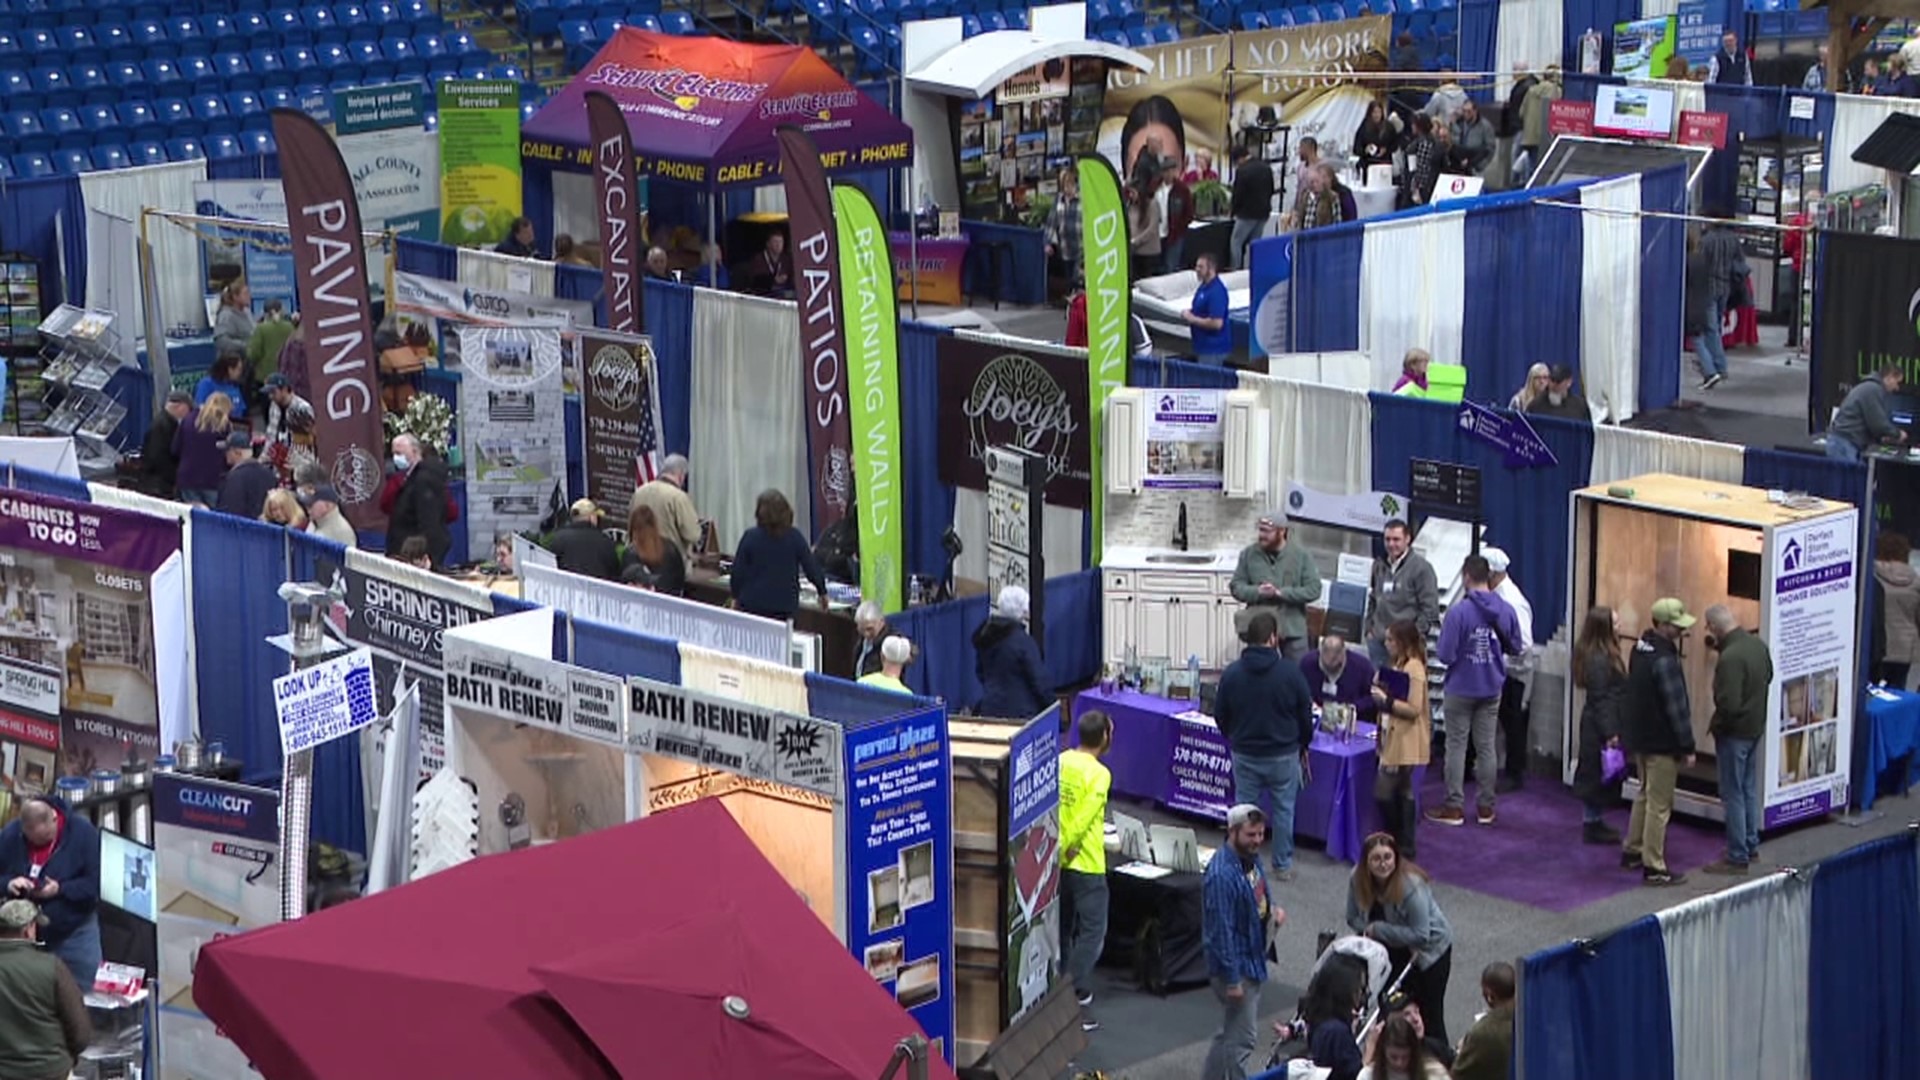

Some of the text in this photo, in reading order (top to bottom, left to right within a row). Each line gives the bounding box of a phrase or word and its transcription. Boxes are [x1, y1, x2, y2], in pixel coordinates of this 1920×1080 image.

[1159, 44, 1218, 82] LIFT
[1249, 29, 1374, 67] NO MORE
[458, 96, 500, 108] Services
[1004, 79, 1040, 97] Homes
[375, 156, 423, 179] COUNTY
[521, 141, 564, 161] CABLE
[656, 159, 706, 182] PHONE
[717, 162, 764, 183] CABLE
[860, 142, 908, 163] PHONE
[302, 199, 372, 422] PAVING
[799, 230, 844, 428] PATIOS
[854, 226, 890, 536] RETAINING WALLS
[0, 498, 76, 528] CABINETS
[27, 521, 50, 541] TO
[51, 526, 77, 546] GO
[95, 571, 144, 592] CLOSETS
[1783, 571, 1816, 588] KITCHEN
[1824, 565, 1844, 578] BATH
[364, 578, 442, 625] SPRING
[1777, 579, 1850, 607] SHOWER SOLUTIONS
[363, 606, 431, 652] Chimney
[5, 669, 57, 695] SPRING HILL
[277, 670, 321, 700] LOOK UP
[470, 661, 543, 692] perma glaze
[447, 672, 493, 707] BATH
[499, 686, 564, 726] RENEW
[74, 718, 115, 738] STORES
[631, 686, 771, 743] BATH RENEW
[9, 720, 55, 742] HILL STOVES
[854, 725, 936, 763] perma glaze
[655, 737, 743, 769] perma glaze
[1014, 776, 1033, 804] FULL
[1032, 757, 1057, 790] ROOF
[1172, 765, 1198, 779] CHECK
[1198, 770, 1214, 781] OUT
[1179, 777, 1226, 798] SHOWROOM
[178, 788, 253, 816] CLEANCUT
